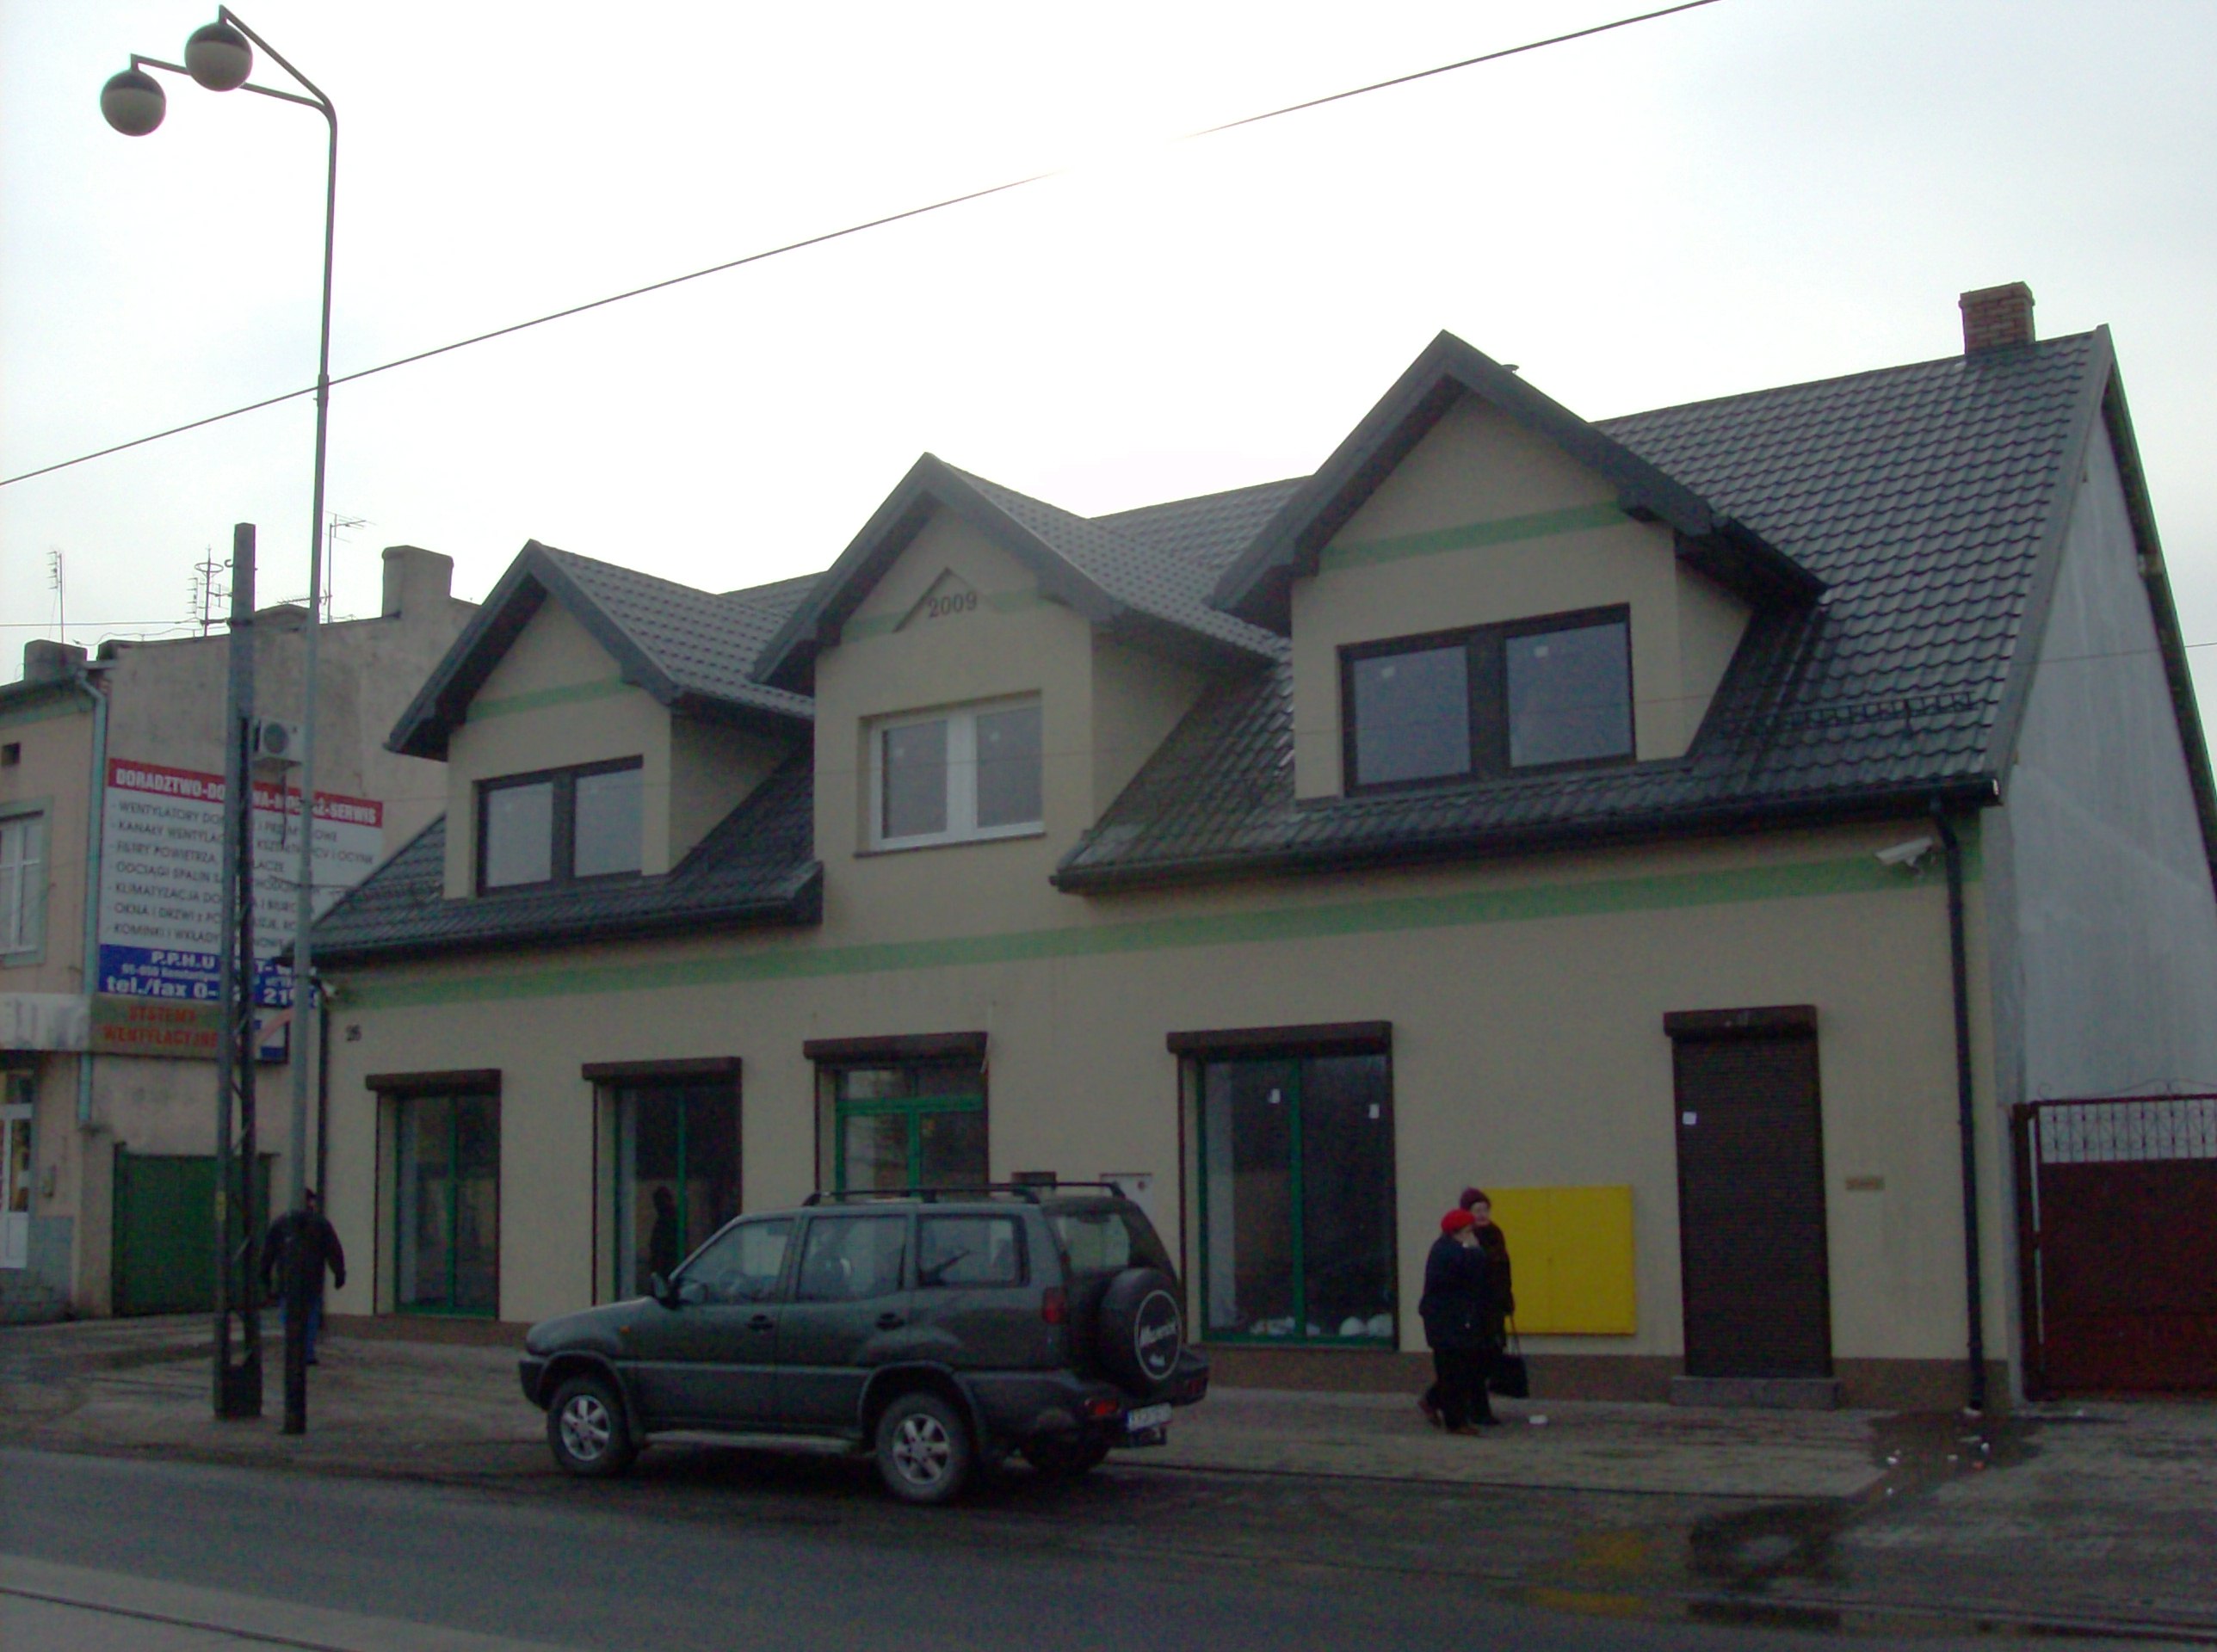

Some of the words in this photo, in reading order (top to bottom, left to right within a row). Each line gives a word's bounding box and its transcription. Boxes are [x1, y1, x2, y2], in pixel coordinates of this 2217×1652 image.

[928, 592, 977, 618] 2009
[119, 800, 199, 820] WENTYLATORY
[115, 883, 200, 901] KLIMATYZACJA
[114, 902, 149, 915] OKNA
[129, 1005, 196, 1023] SYSTEMY
[103, 1025, 219, 1047] WENTYLACYJNE
